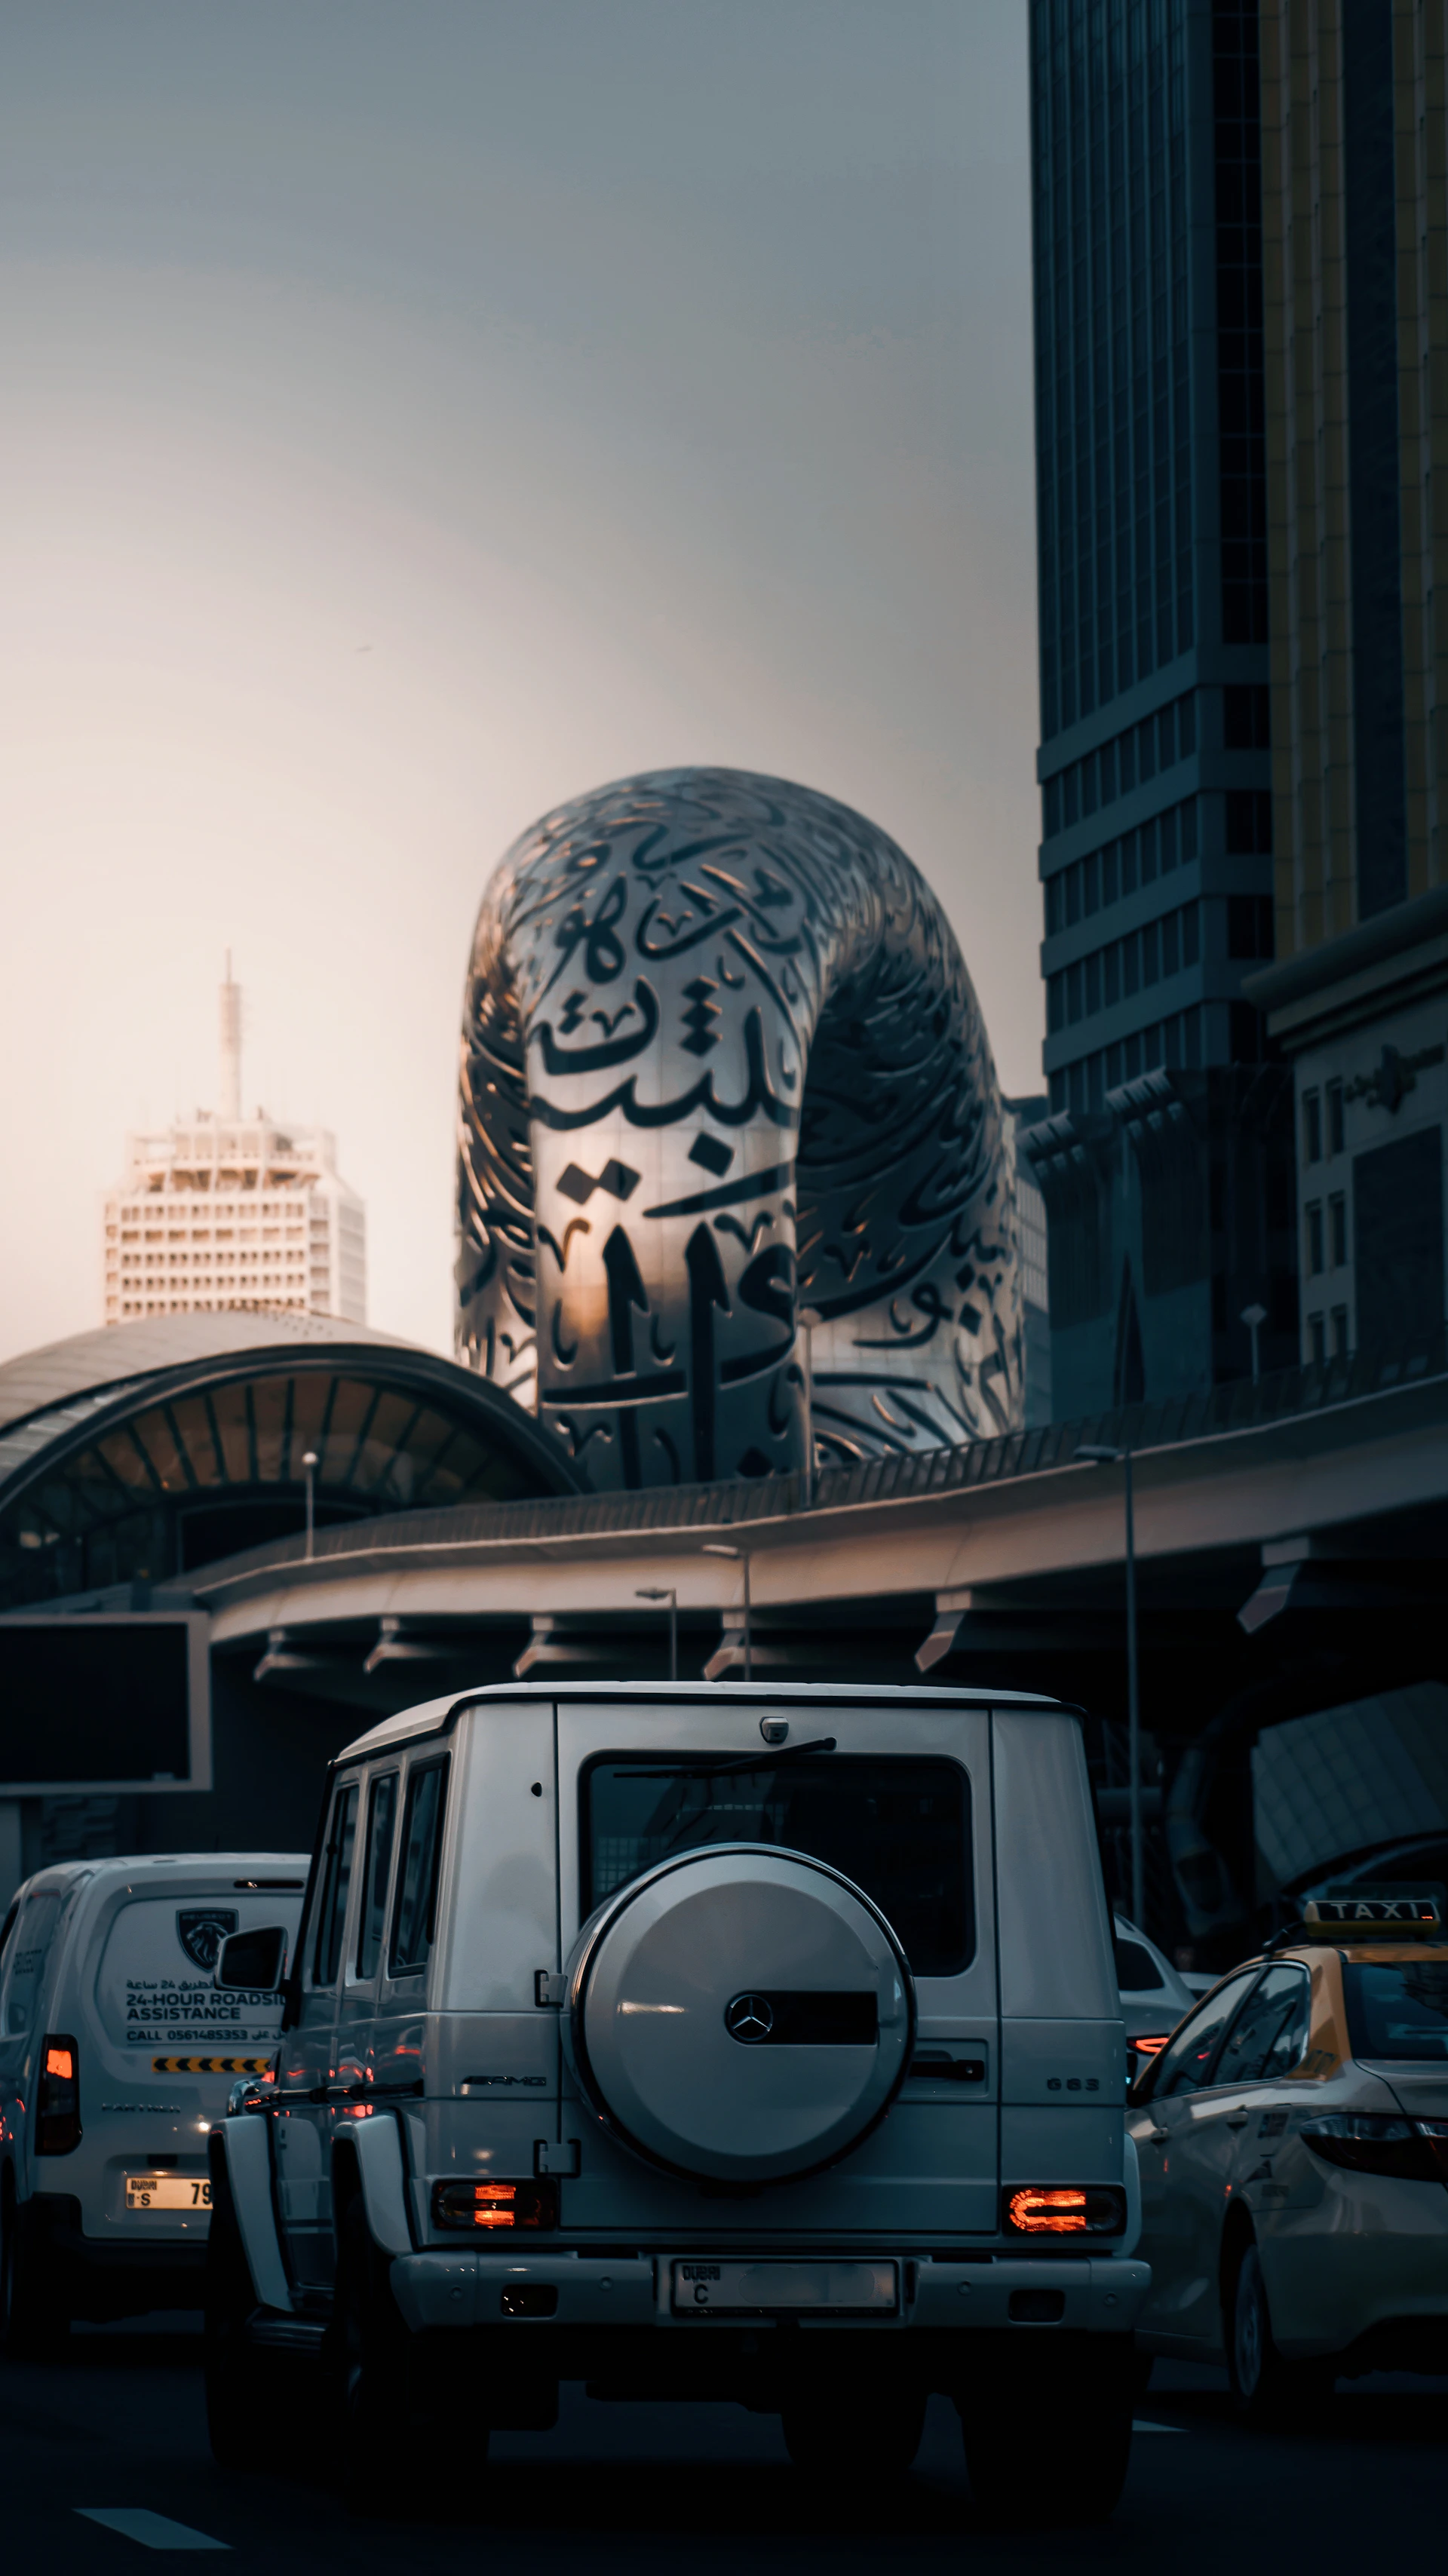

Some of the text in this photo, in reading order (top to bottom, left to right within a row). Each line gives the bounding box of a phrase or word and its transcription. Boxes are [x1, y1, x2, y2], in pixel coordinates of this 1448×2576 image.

[1330, 1903, 1419, 1919] TAXI
[161, 1980, 176, 1989] 24
[127, 1993, 205, 2007] 24-HOUR
[127, 2007, 241, 2020] ASSISTANCE
[127, 2030, 162, 2041] CALL
[167, 2030, 247, 2041] 0561485353
[141, 2193, 151, 2206] S
[192, 2182, 212, 2205] 79
[695, 2284, 708, 2305] C
